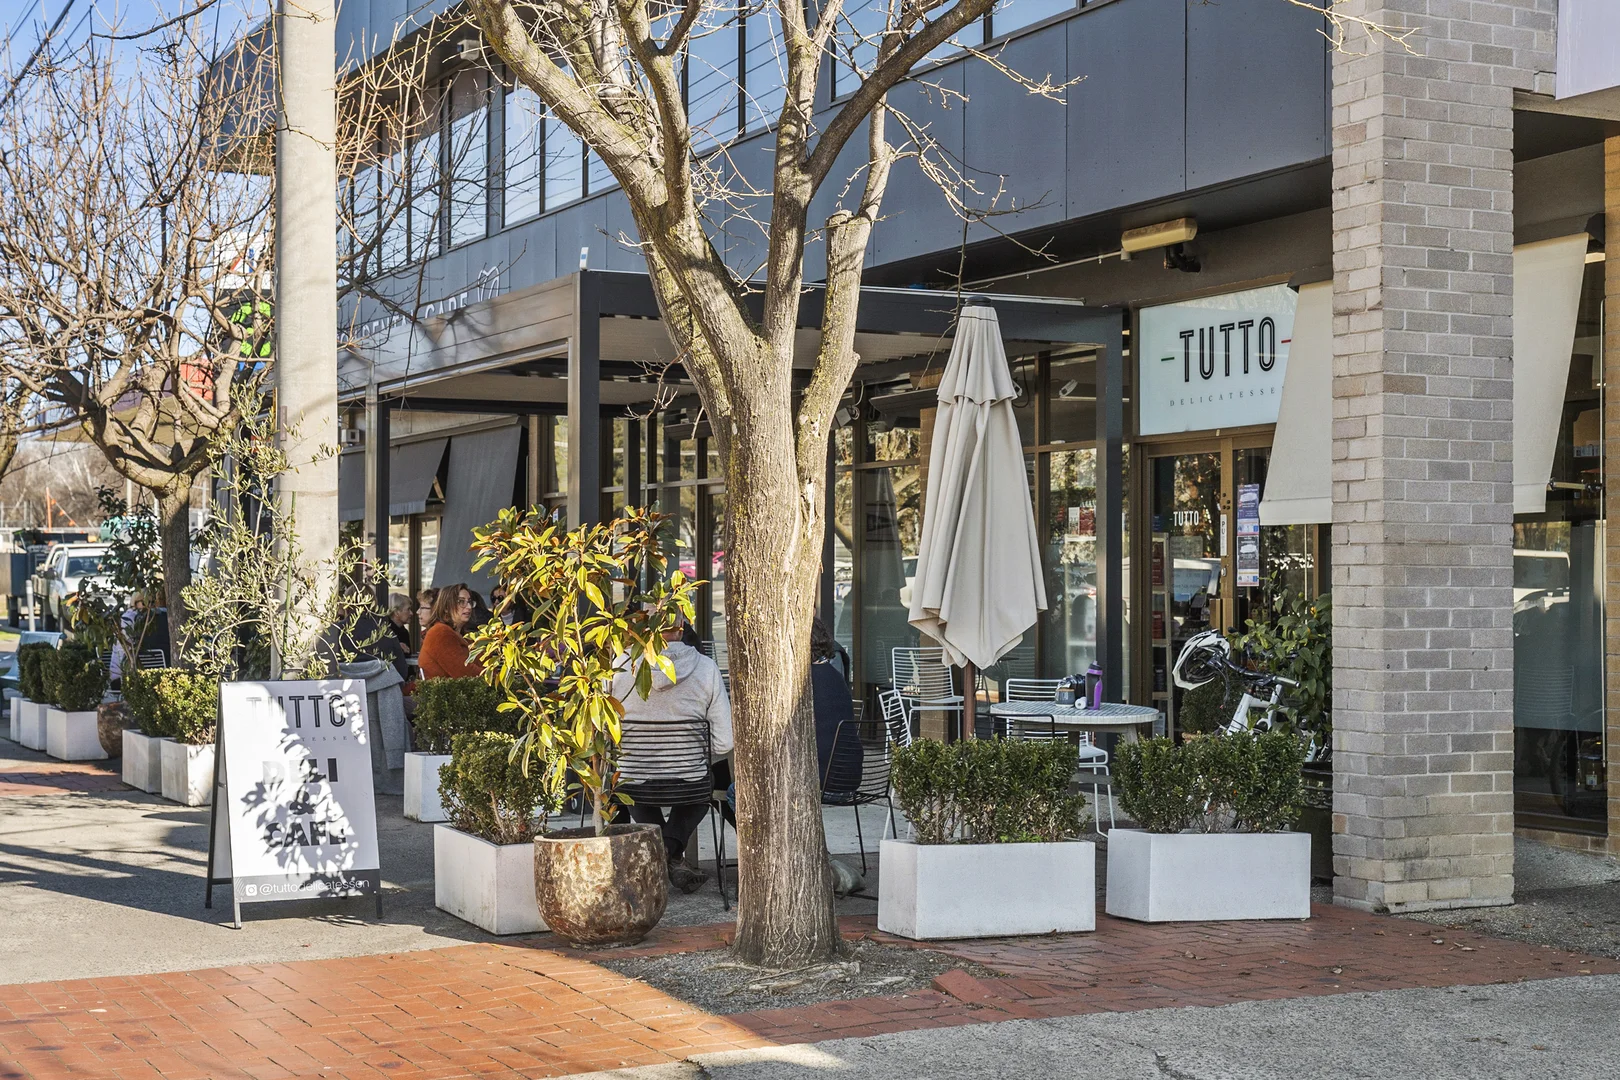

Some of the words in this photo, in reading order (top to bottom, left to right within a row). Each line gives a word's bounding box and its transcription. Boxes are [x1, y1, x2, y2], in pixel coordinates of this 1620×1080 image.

[1179, 316, 1276, 383] TUTTO
[1169, 386, 1284, 406] DELICATESSE
[1173, 510, 1200, 527] TUTTO
[259, 879, 370, 896] @tuttodelicatessen
